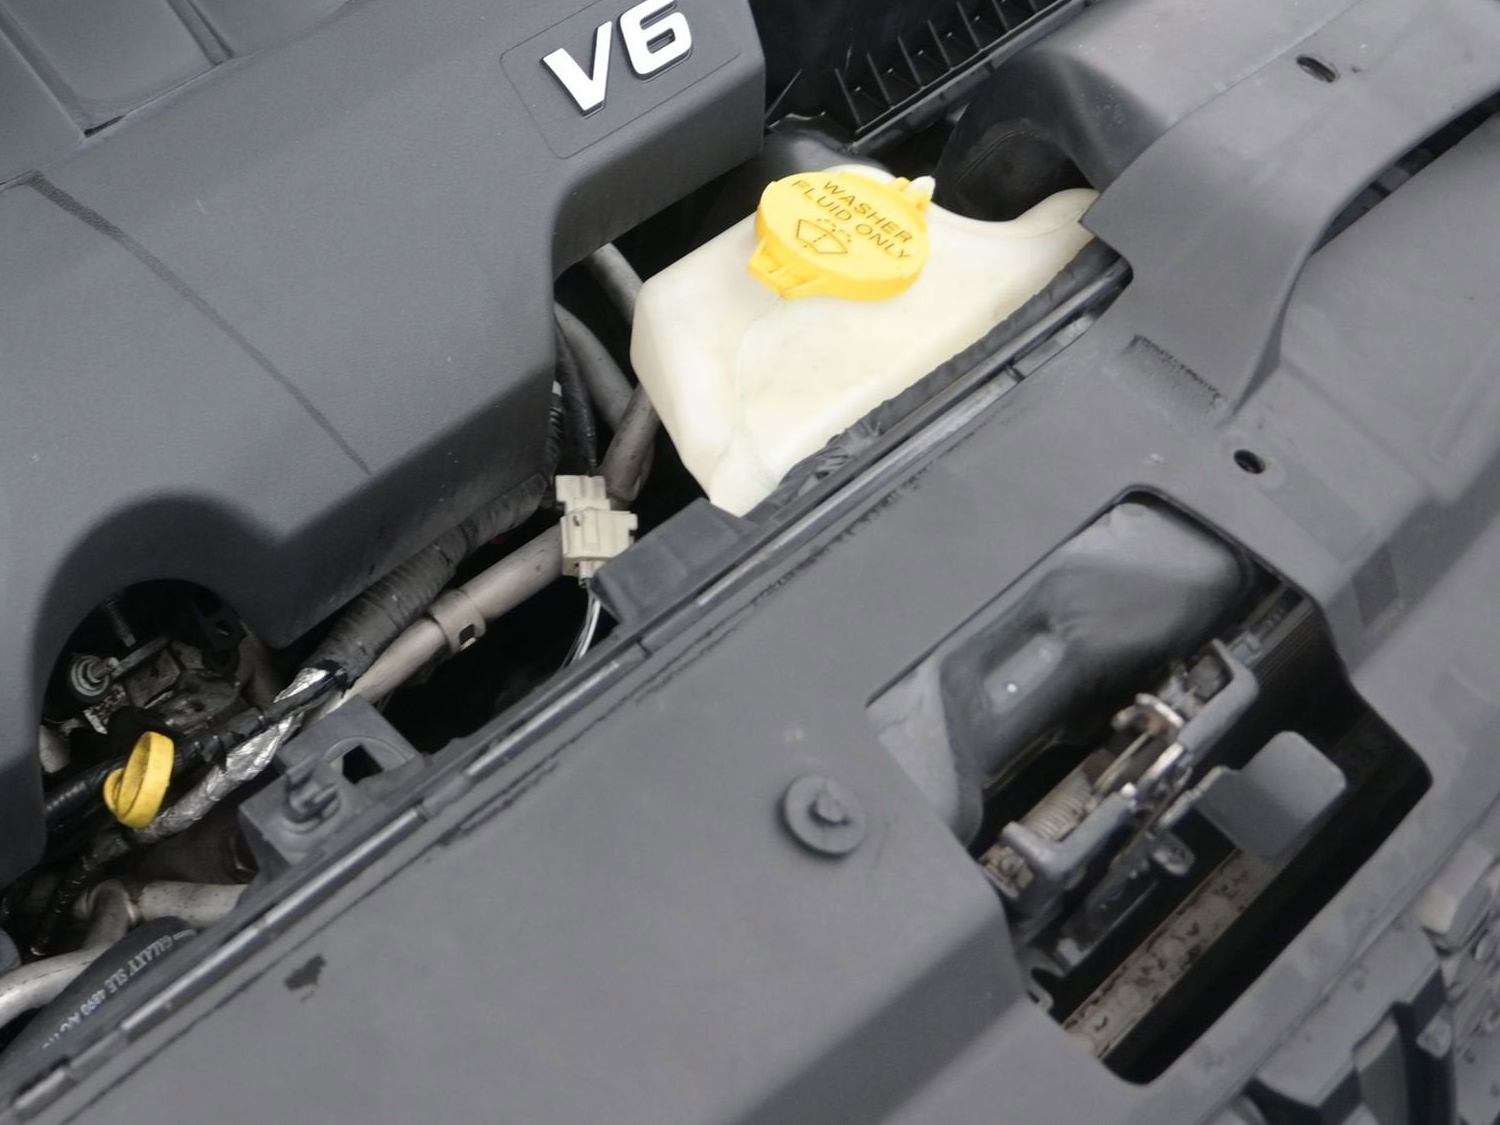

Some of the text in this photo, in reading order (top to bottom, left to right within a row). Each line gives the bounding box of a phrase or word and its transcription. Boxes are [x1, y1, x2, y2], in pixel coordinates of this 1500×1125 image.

[791, 179, 912, 260] FLUID ONLY
[823, 180, 913, 244] WASHER
